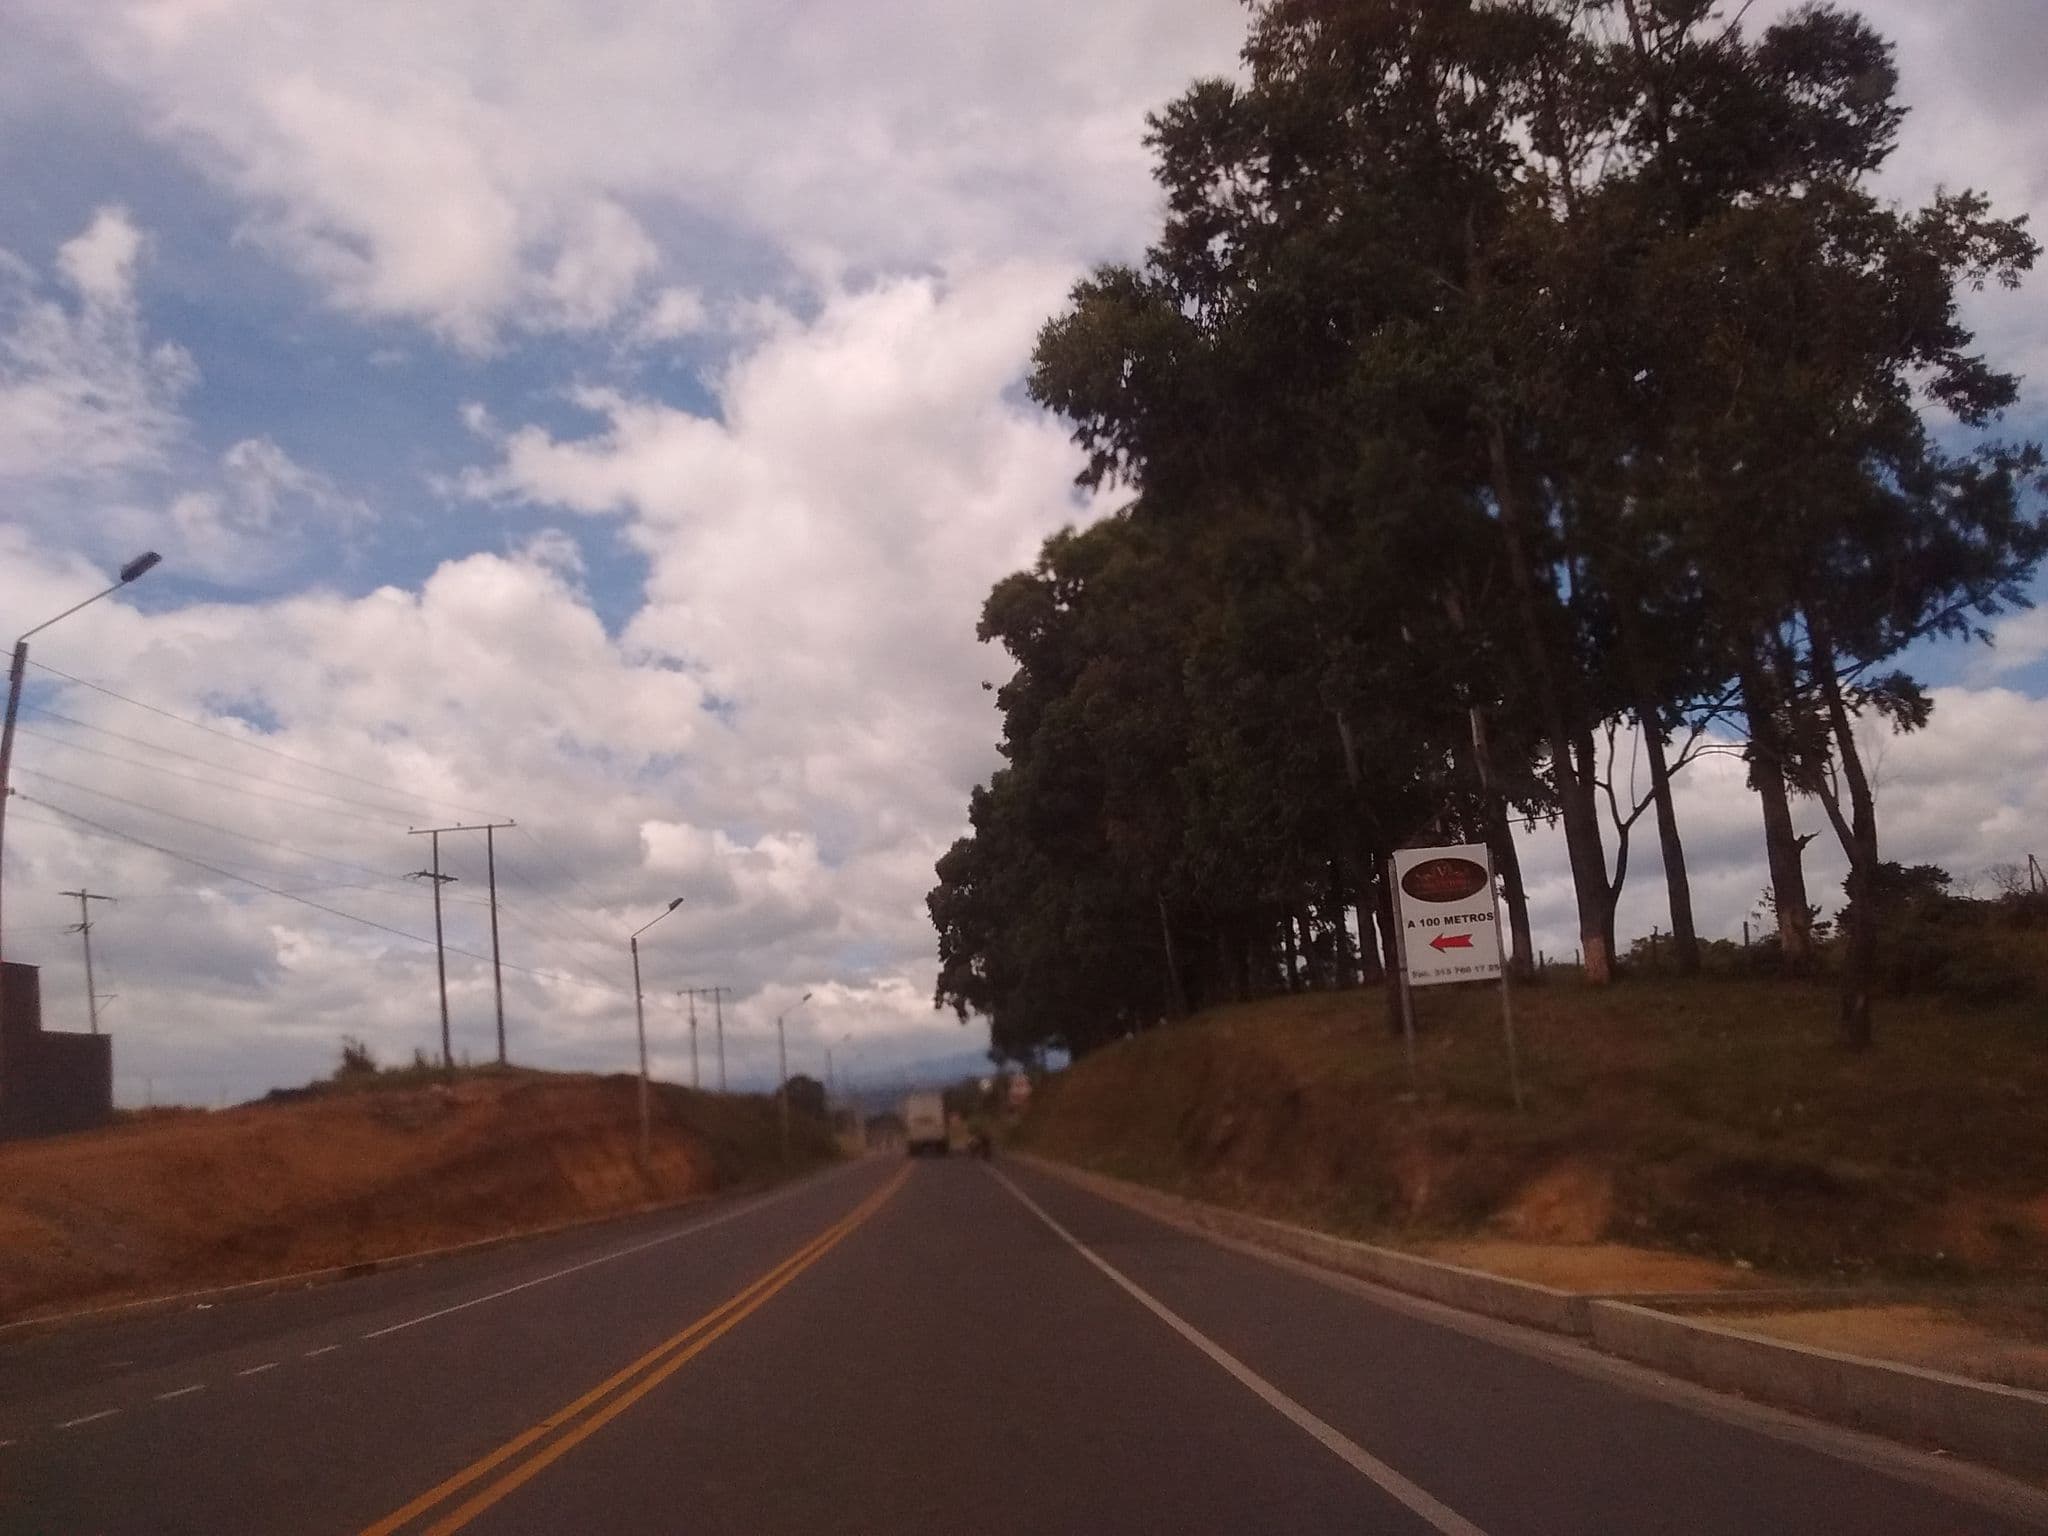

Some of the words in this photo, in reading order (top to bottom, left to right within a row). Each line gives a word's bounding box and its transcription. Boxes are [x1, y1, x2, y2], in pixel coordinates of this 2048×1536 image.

[1407, 920, 1416, 929] A
[1419, 917, 1441, 927] 100
[1443, 912, 1494, 925] METROS
